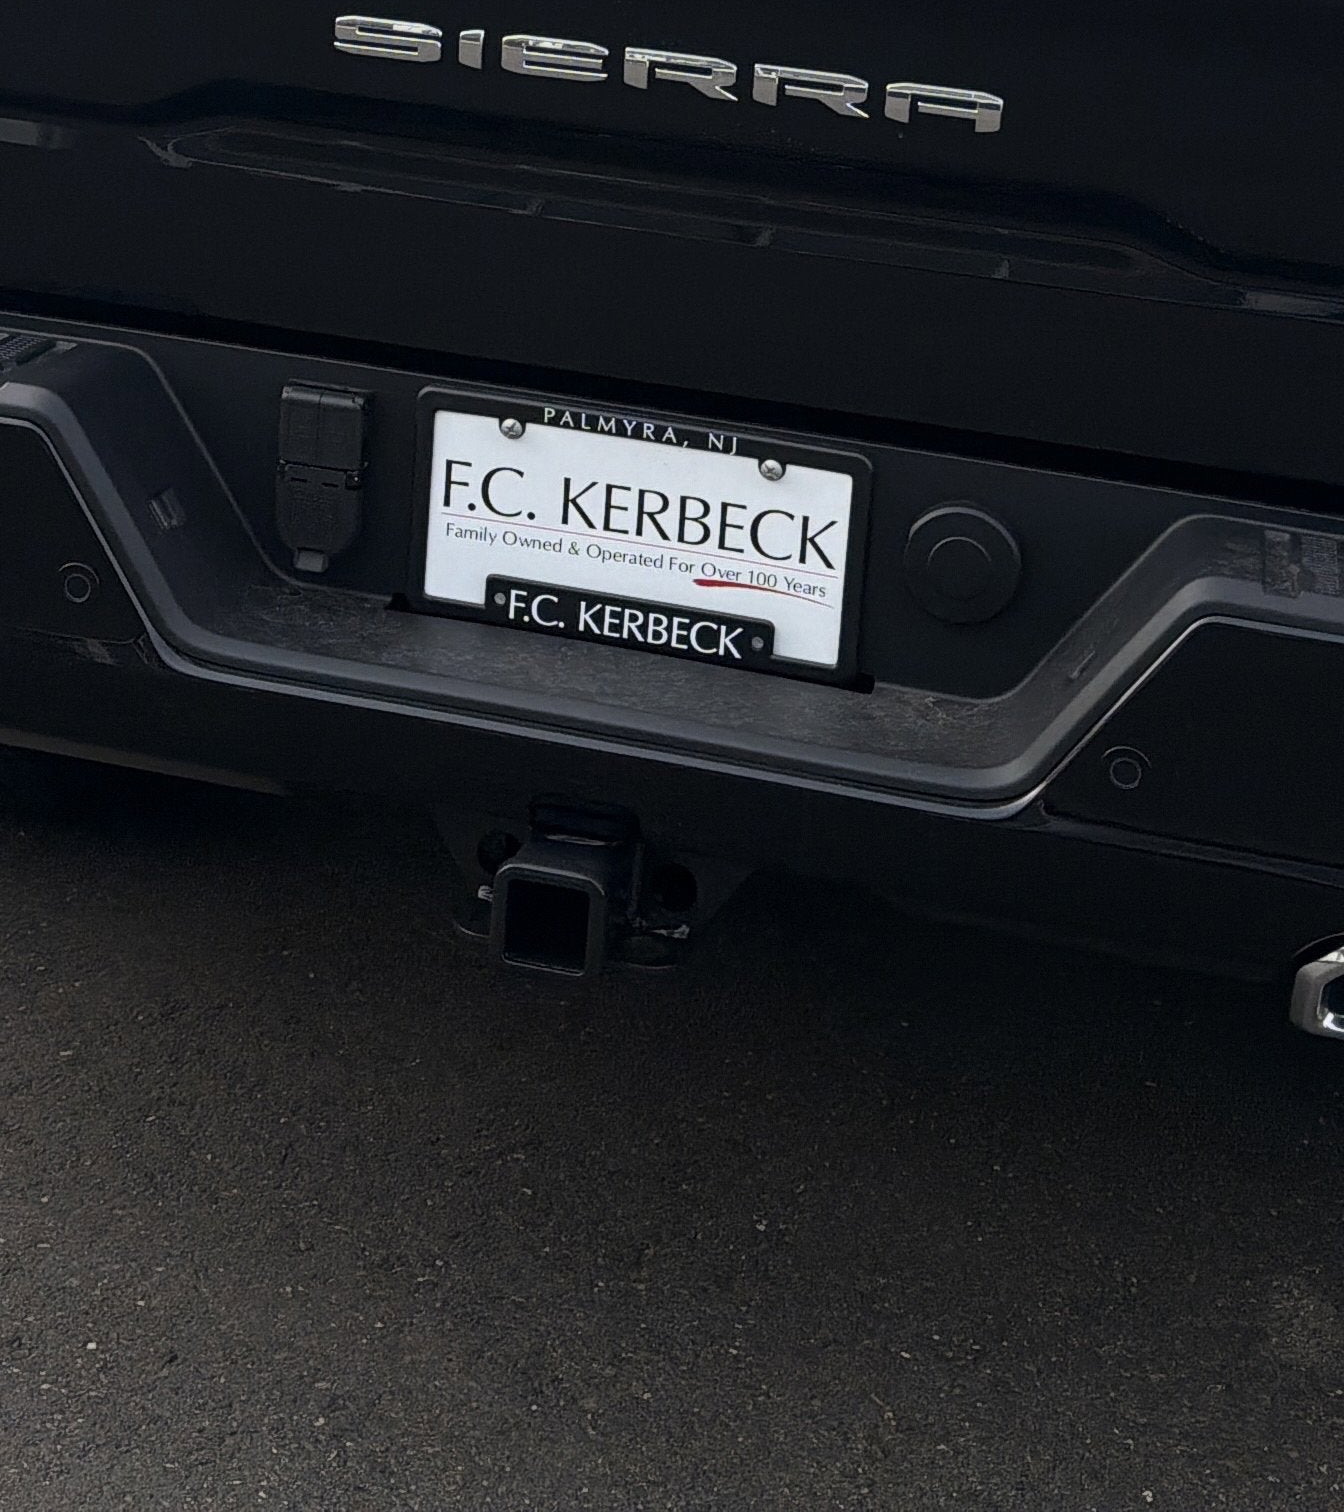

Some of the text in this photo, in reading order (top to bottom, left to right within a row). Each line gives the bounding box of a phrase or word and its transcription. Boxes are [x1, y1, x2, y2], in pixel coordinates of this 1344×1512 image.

[333, 14, 1004, 133] SIERRA
[543, 407, 739, 456] PALMYRA, NJ
[442, 458, 839, 570] F.C. KERBECK
[445, 521, 827, 599] Family Owned & Operated For Over 100 Years
[507, 589, 744, 660] F.C. KERBECK
